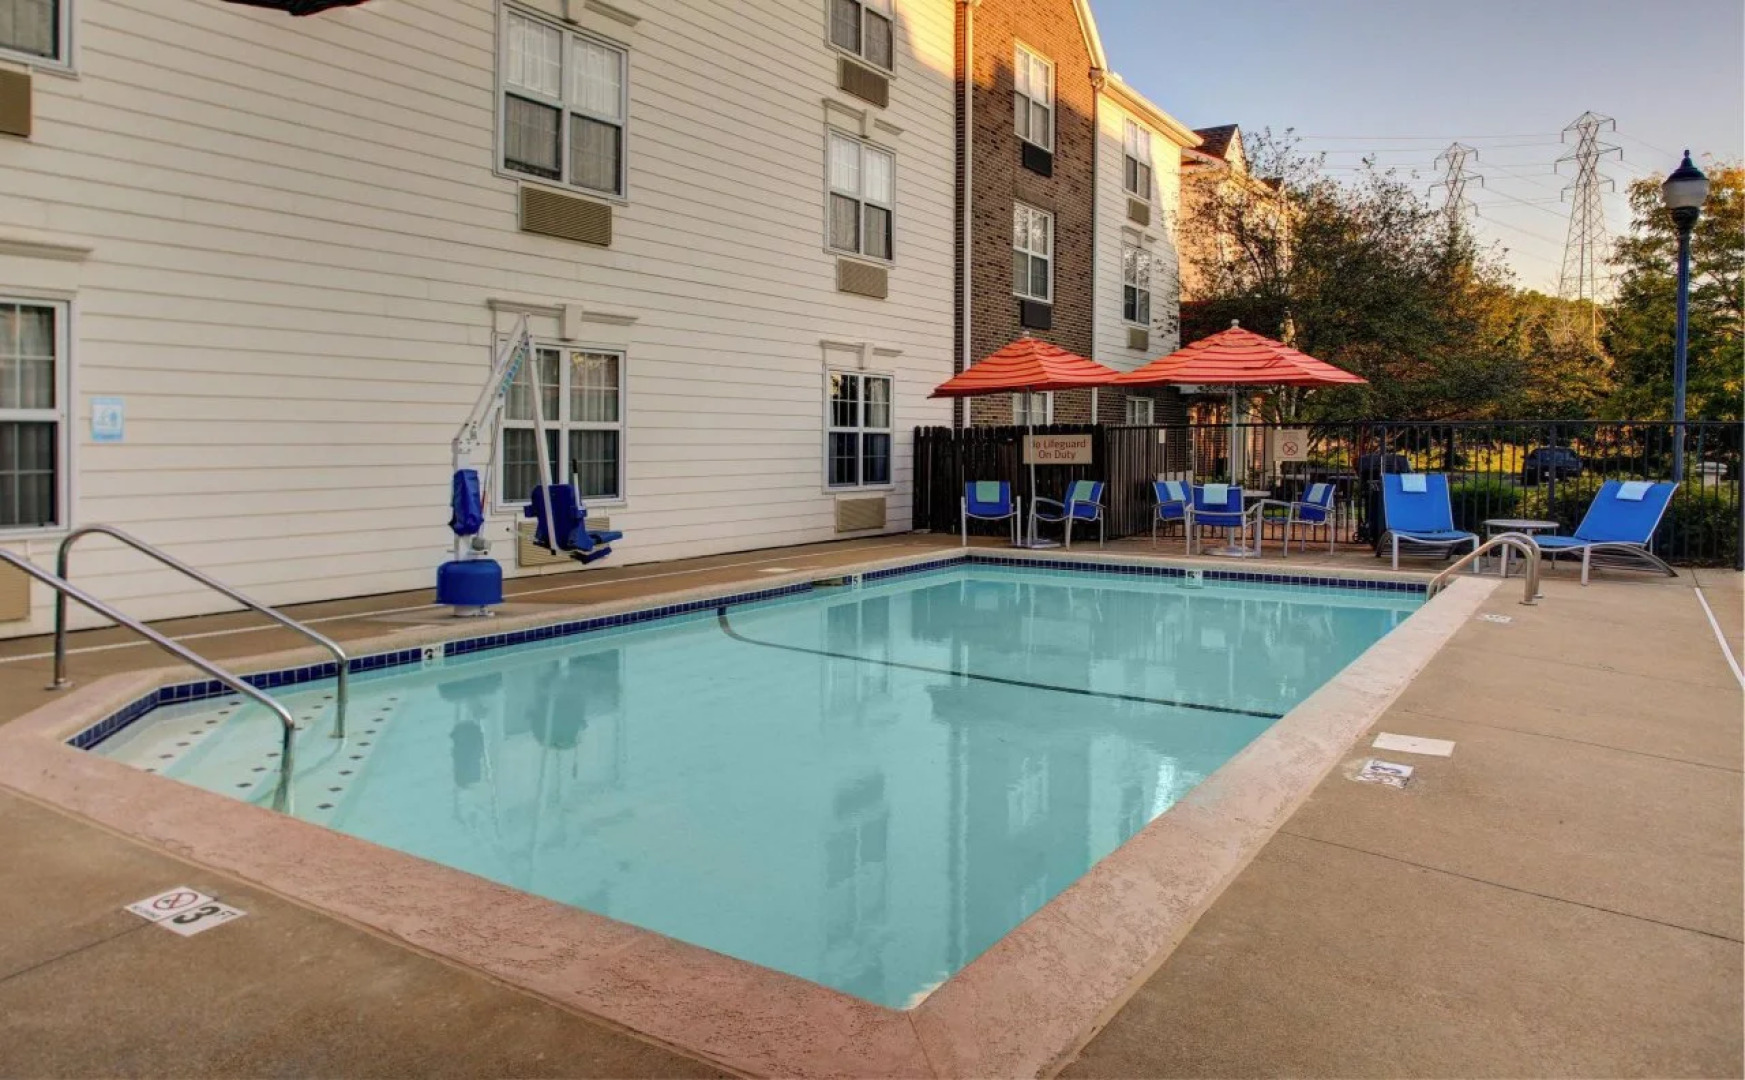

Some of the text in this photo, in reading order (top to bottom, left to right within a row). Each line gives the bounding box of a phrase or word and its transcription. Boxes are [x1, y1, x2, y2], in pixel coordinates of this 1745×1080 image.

[1044, 439, 1086, 450] Lifeguard
[1038, 450, 1076, 460] On Duty
[172, 906, 221, 924] 3
